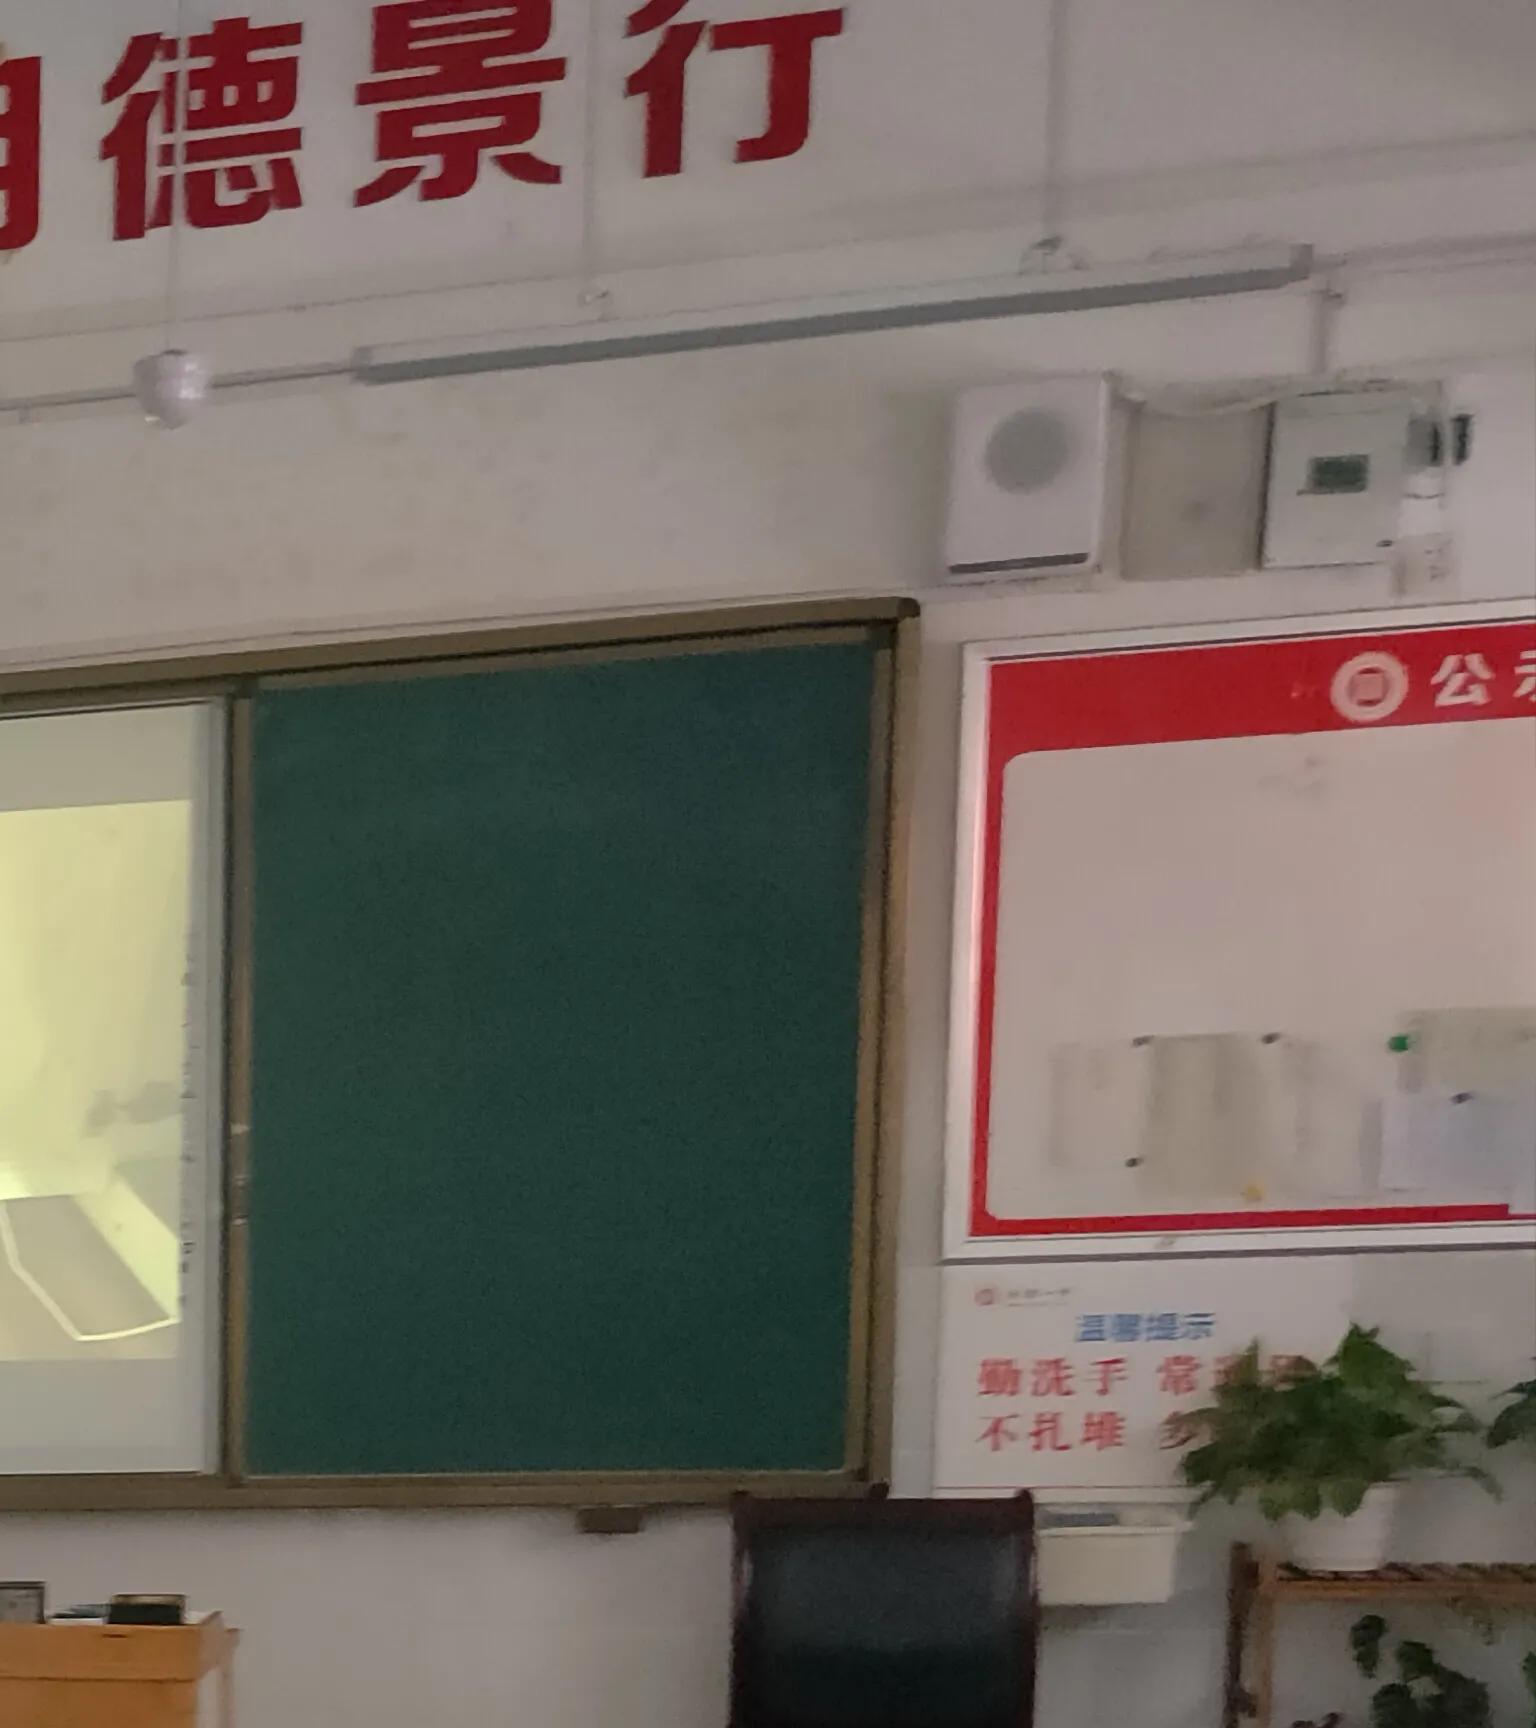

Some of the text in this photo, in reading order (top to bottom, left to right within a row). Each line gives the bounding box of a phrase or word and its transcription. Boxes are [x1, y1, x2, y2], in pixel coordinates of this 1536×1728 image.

[1076, 1312, 1217, 1342] 温馨提示
[975, 1411, 1128, 1452] 不扎堆
